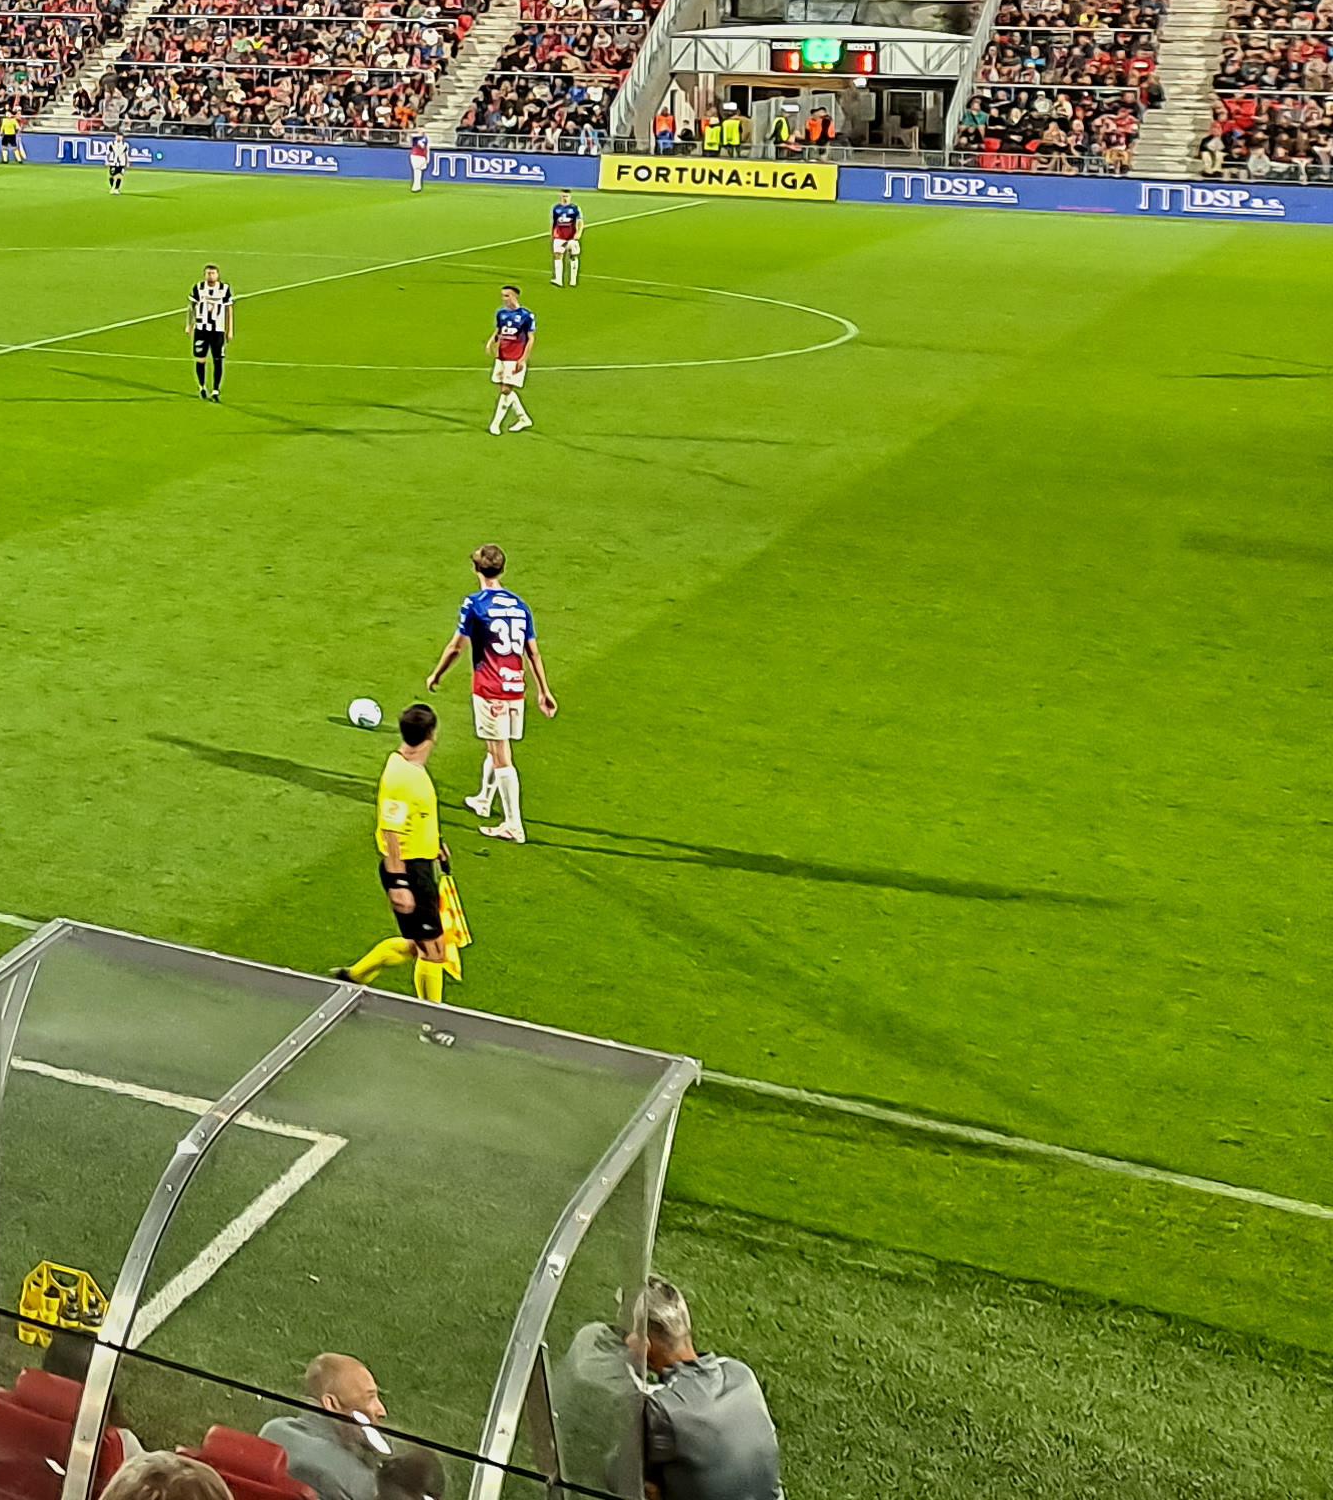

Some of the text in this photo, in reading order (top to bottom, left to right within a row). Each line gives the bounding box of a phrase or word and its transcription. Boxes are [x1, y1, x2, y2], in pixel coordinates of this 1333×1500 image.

[274, 148, 312, 164] DSP
[474, 157, 517, 174] DSP
[933, 178, 982, 195] DSP
[1192, 188, 1250, 207] DSP
[490, 618, 526, 656] 35
